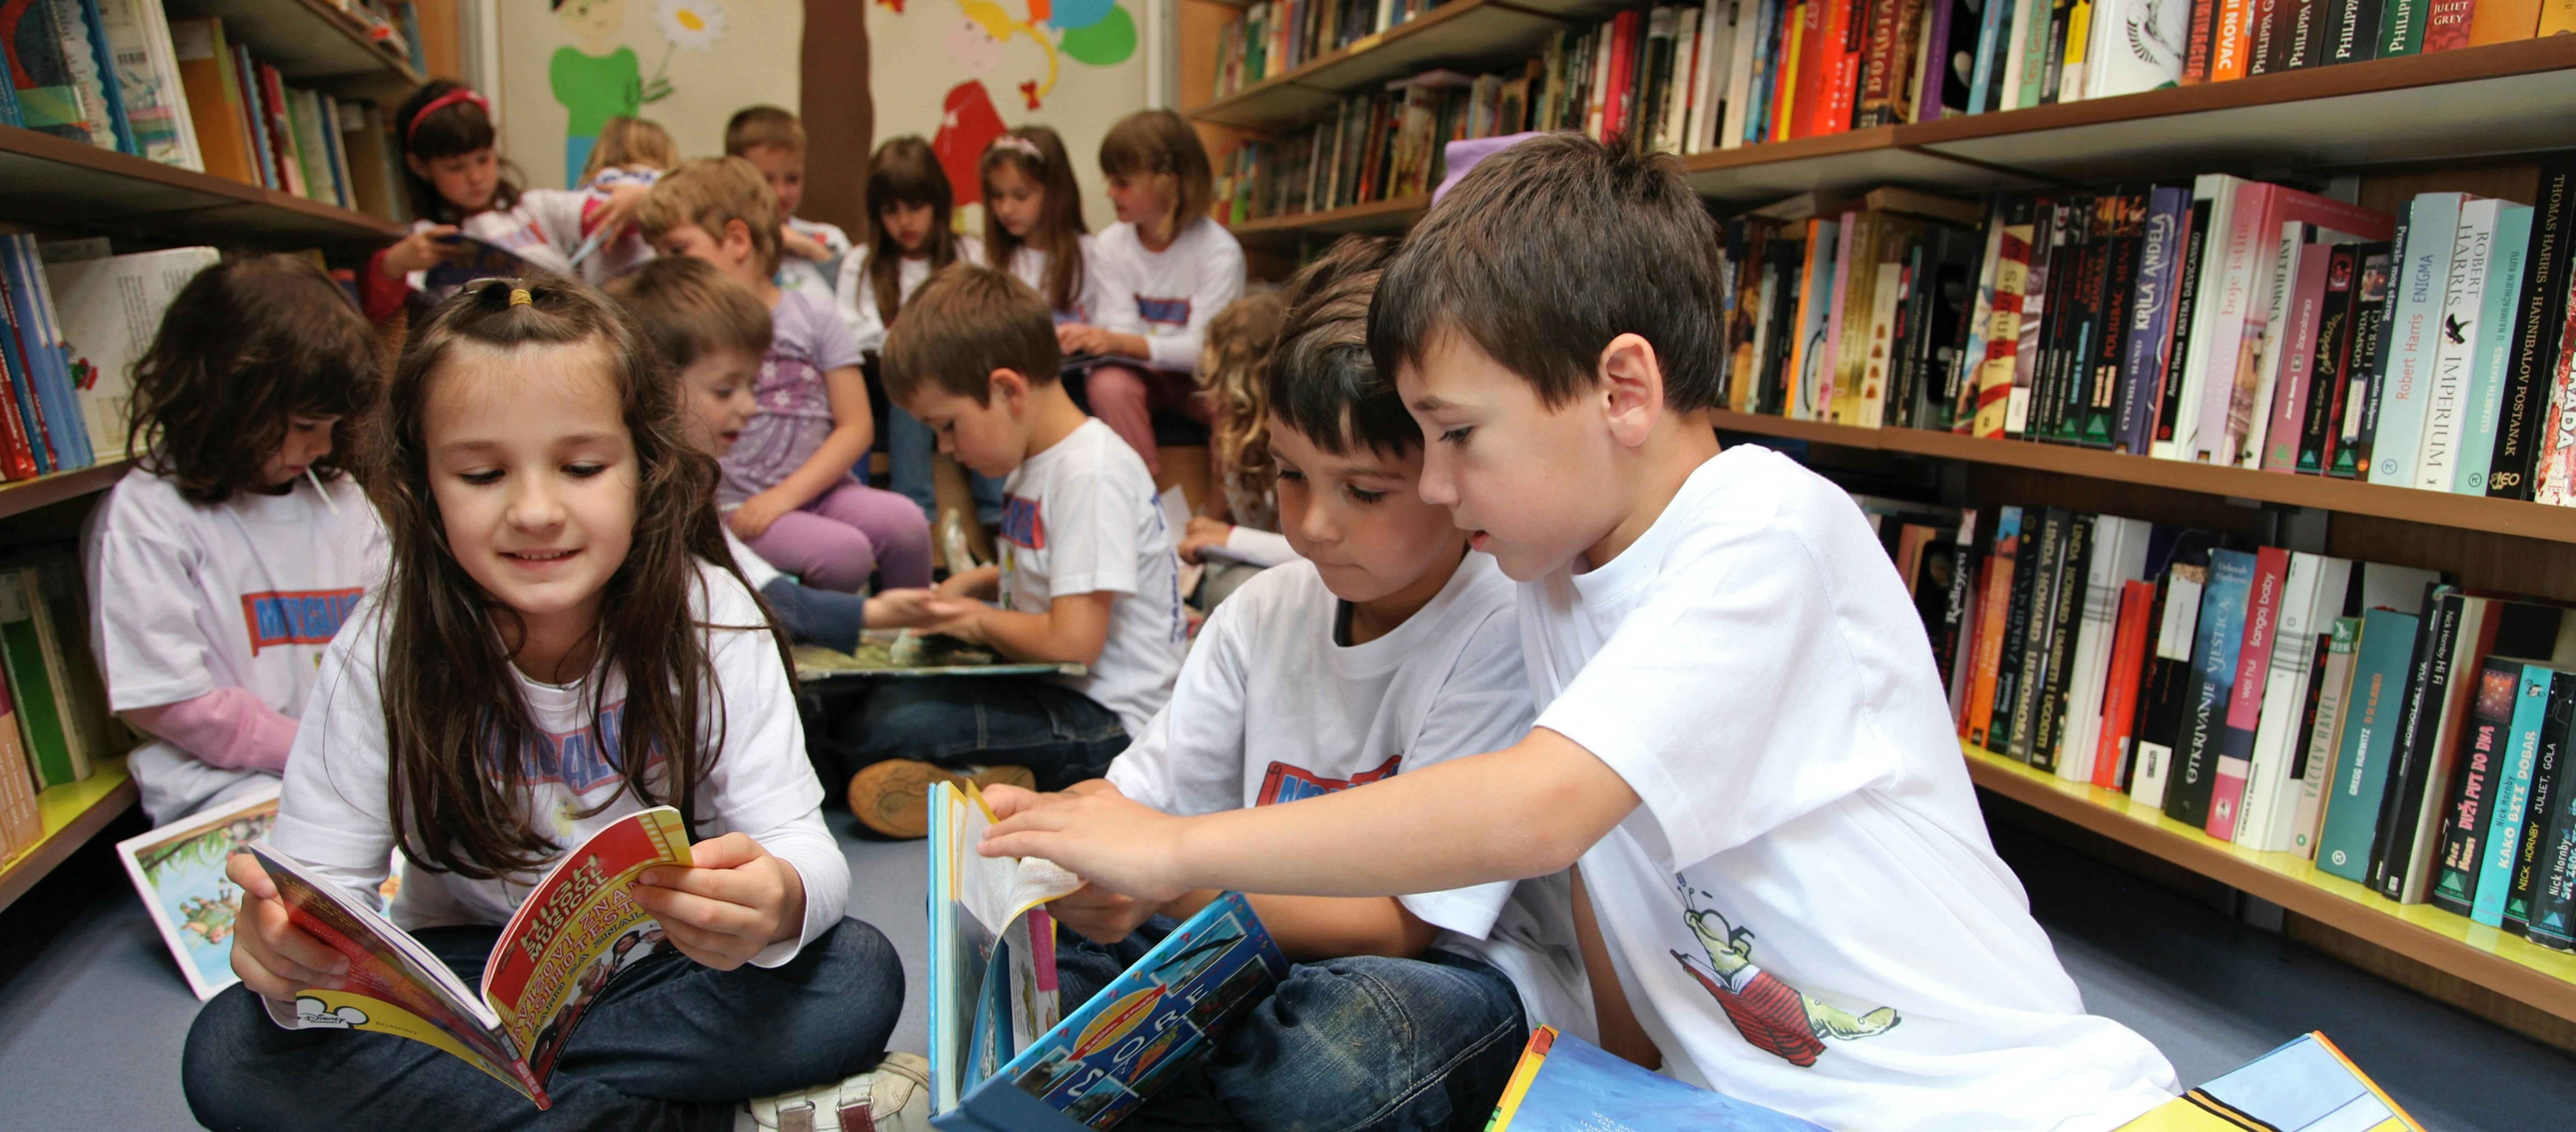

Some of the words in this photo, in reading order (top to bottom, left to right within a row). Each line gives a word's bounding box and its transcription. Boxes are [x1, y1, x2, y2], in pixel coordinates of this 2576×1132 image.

[2028, 0, 2052, 60] Gerritse
[2433, 2, 2469, 14] JULIET
[2433, 15, 2465, 25] GREY
[2218, 12, 2239, 70] NOVAC
[2252, 13, 2273, 74] PHILIPPA
[2289, 4, 2312, 67] PHILIPPA
[2544, 174, 2566, 232] THOMAS
[2229, 221, 2248, 269] istine
[2448, 225, 2473, 305] HARRIS
[2467, 232, 2489, 298] ROBERT
[2536, 234, 2555, 283] HARRIS
[2221, 275, 2243, 316] boje
[2412, 254, 2434, 303] ENIGMA
[2135, 282, 2161, 330] KRILA
[2177, 297, 2192, 336] EKSTRA
[2352, 310, 2369, 368] GOSPODA
[2405, 313, 2423, 352] Harris
[2480, 383, 2496, 433] ELIZABETH
[2490, 347, 2503, 382] HAYNES
[2497, 275, 2515, 333] NAJMRAČNIJEM
[2509, 252, 2520, 274] KUTU
[2515, 297, 2543, 385] HANNIBALOV
[2121, 378, 2137, 431] CYNTHIA
[2130, 339, 2143, 375] HAND
[2166, 371, 2179, 397] Annie
[2396, 357, 2417, 400] Robert
[2427, 357, 2462, 467] IMPERIUM
[2505, 385, 2527, 457] POSTANAK
[2038, 519, 2058, 570] LINDA
[2066, 523, 2084, 564] LINDA
[2029, 572, 2051, 642] HOWARD
[2059, 566, 2076, 624] HOWARD
[2246, 659, 2257, 679] hui
[2260, 572, 2276, 607] baby
[2444, 611, 2454, 628] Nick
[2435, 661, 2446, 673] Hi
[2436, 630, 2450, 660] Hornby
[2417, 661, 2427, 682] VUK
[2432, 675, 2444, 685] Fi
[2186, 681, 2215, 785] OTKRIVANJE
[2318, 695, 2337, 742] HAVEL
[2477, 725, 2495, 751] DNA
[2355, 727, 2371, 768] HURWITZ
[2471, 753, 2488, 773] DO
[2516, 730, 2537, 782] DOBAR
[2349, 767, 2362, 796] GREGG
[2464, 774, 2482, 801] PUT
[2499, 774, 2516, 801] Hornby
[2508, 783, 2529, 823] BITI
[2495, 804, 2506, 828] Nick
[2518, 865, 2530, 891] NICK
[2524, 821, 2540, 863] HORNBY
[2534, 774, 2551, 814] JULIET,
[2543, 742, 2557, 770] GOLA
[2497, 825, 2516, 869] KAKO
[2554, 839, 2573, 873] Hornby
[520, 853, 600, 945] HIGH
[2549, 874, 2562, 896] Nick
[2561, 881, 2573, 900] SVE
[526, 869, 604, 954] SCHOOL
[529, 876, 610, 963] MUSICAL
[511, 932, 575, 1043] KVIZOVI
[532, 981, 565, 1037] SAMO
[568, 954, 589, 977] ZA
[1067, 983, 1209, 1097] MORE
